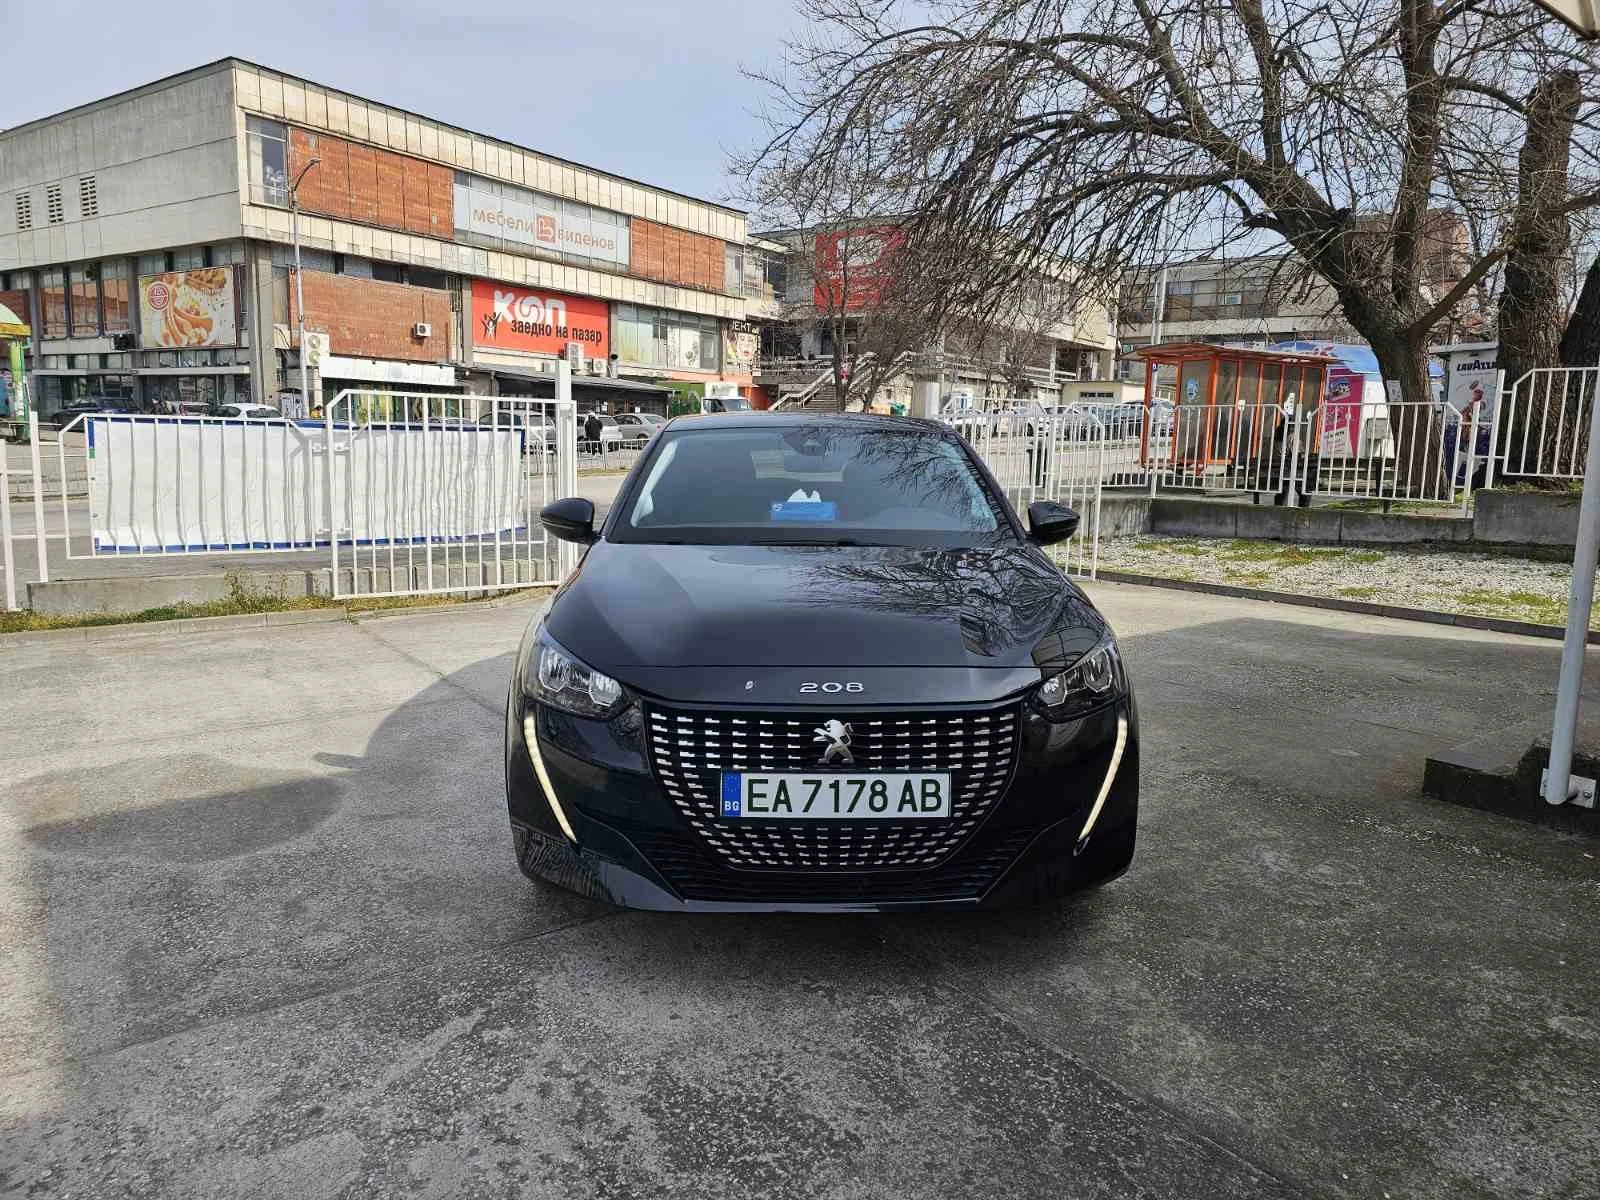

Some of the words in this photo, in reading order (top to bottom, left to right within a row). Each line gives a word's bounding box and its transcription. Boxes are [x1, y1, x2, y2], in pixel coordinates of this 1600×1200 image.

[511, 319, 552, 338] заедно
[556, 325, 568, 339] на
[572, 327, 602, 346] пазар
[800, 682, 864, 693] 208
[747, 778, 792, 813] EA
[802, 778, 888, 813] 7178
[897, 778, 942, 813] AB
[724, 801, 739, 811] BG
